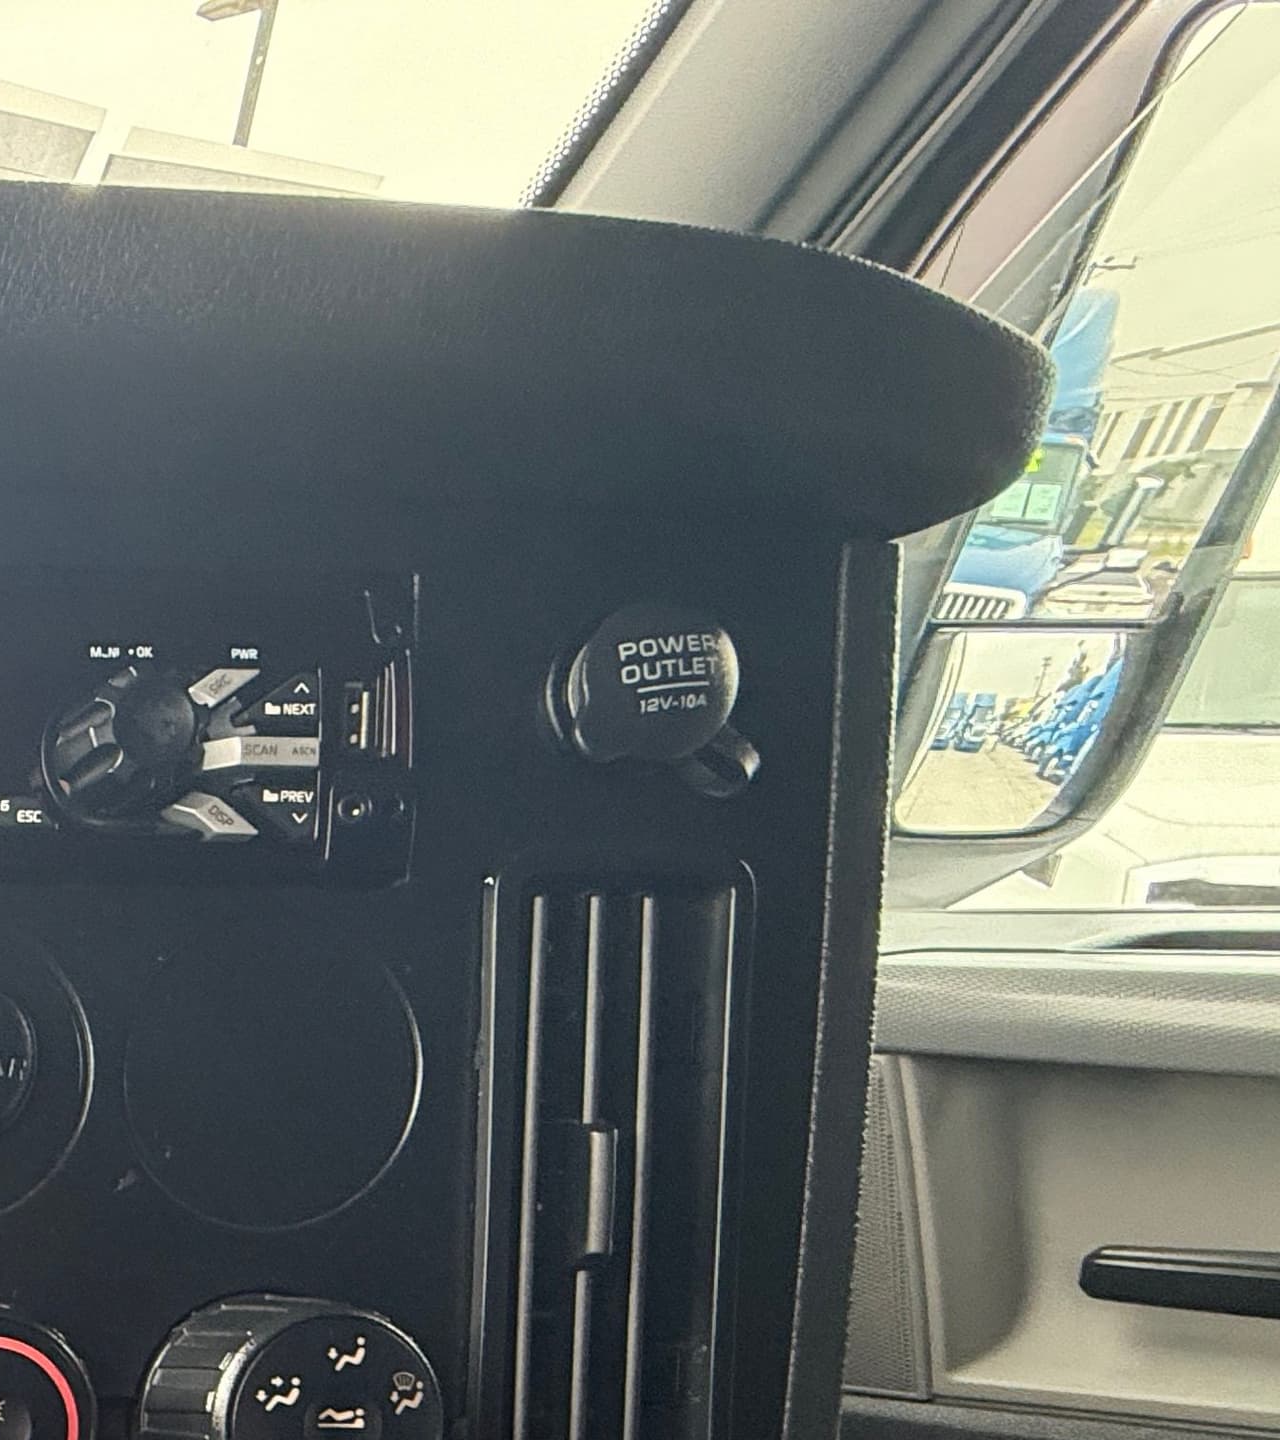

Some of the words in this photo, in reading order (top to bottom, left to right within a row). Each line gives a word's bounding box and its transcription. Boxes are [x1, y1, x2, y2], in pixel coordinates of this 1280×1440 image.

[136, 646, 154, 658] OK
[231, 648, 258, 660] PWR
[618, 634, 720, 662] POWER
[620, 656, 719, 685] OUTLET
[283, 703, 316, 716] NEXT
[639, 694, 708, 714] 12V-10A
[243, 743, 278, 756] SCAN
[280, 790, 314, 803] PREV
[0, 800, 10, 812] 6
[16, 810, 42, 824] ESC
[208, 804, 235, 827] DISP
